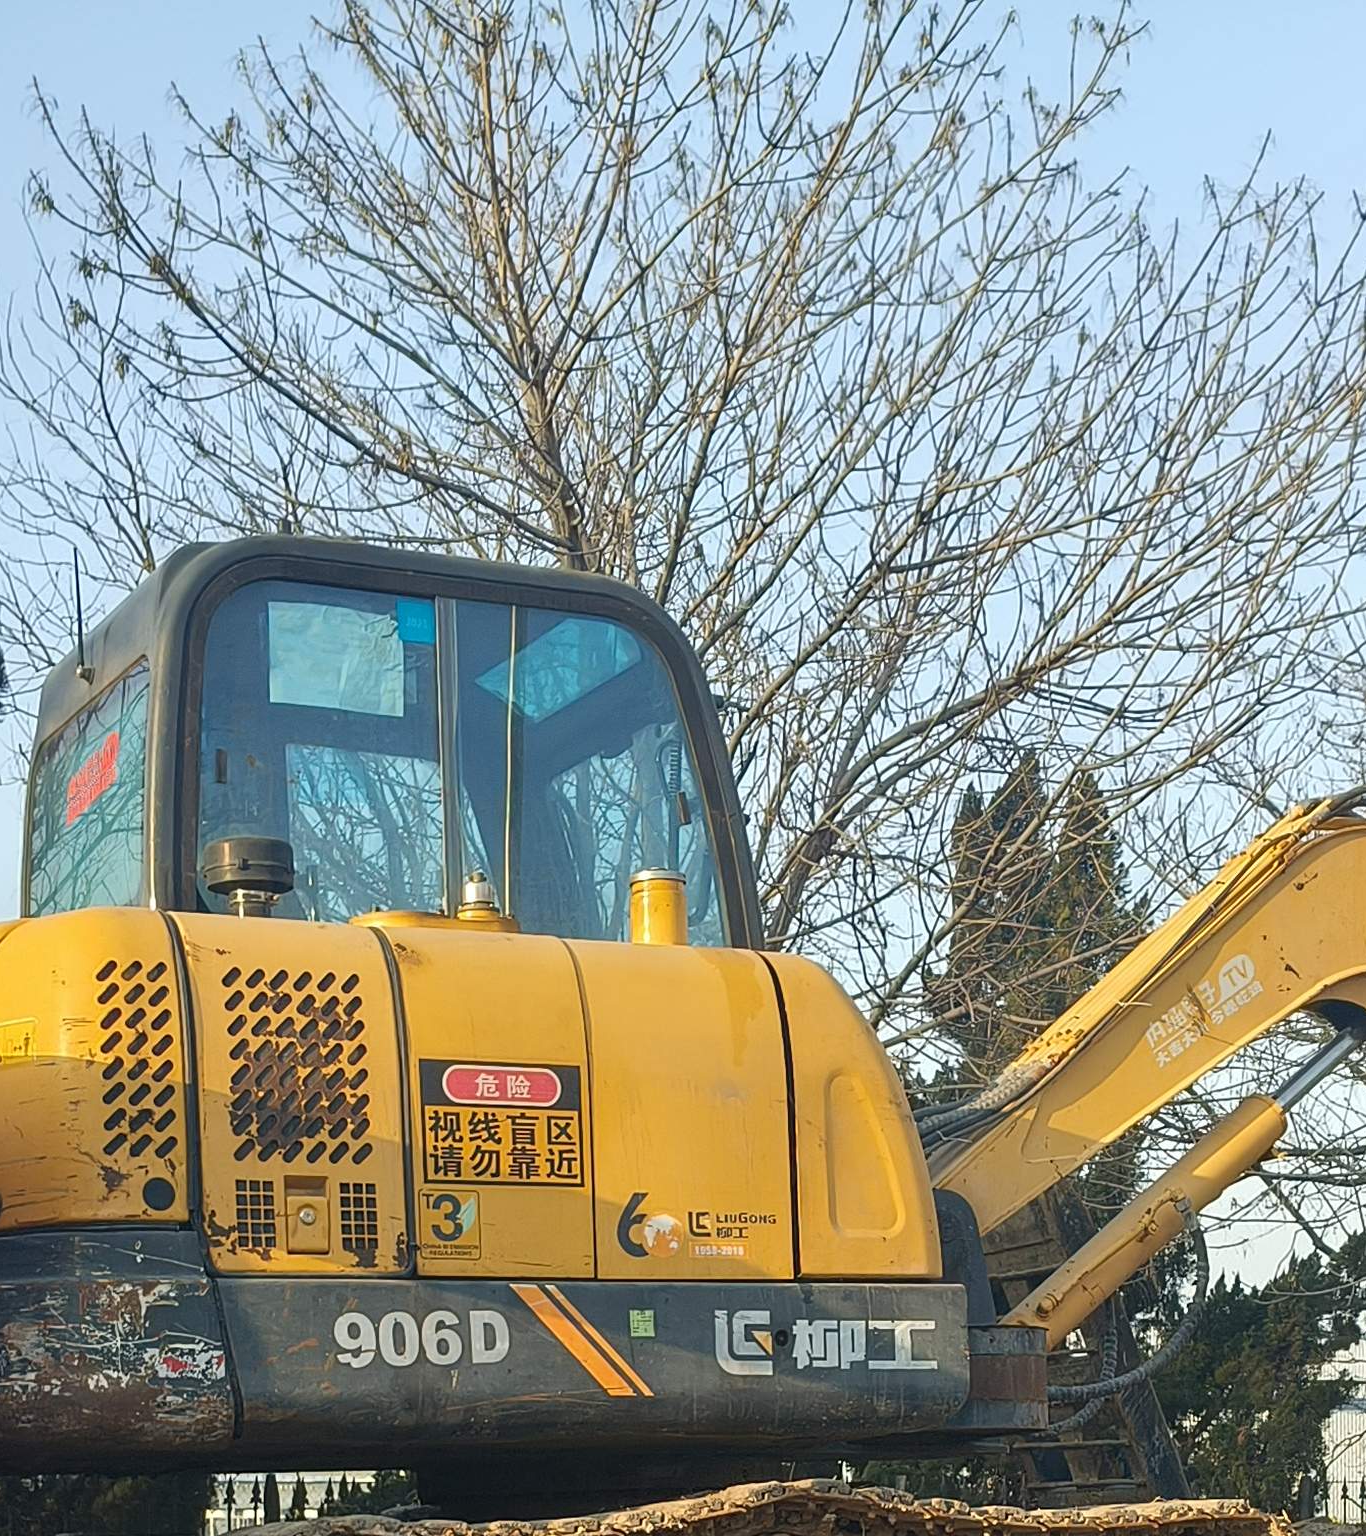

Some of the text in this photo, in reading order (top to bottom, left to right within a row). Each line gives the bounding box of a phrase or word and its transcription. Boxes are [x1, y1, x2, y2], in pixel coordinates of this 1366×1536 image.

[474, 1072, 532, 1099] 危险
[428, 1110, 577, 1146] 视线盲区
[428, 1144, 578, 1180] 请勿靠近
[431, 1193, 464, 1242] 3
[716, 1227, 749, 1239] 柳工
[334, 1308, 511, 1370] 906D
[792, 1318, 939, 1370] 柳工
